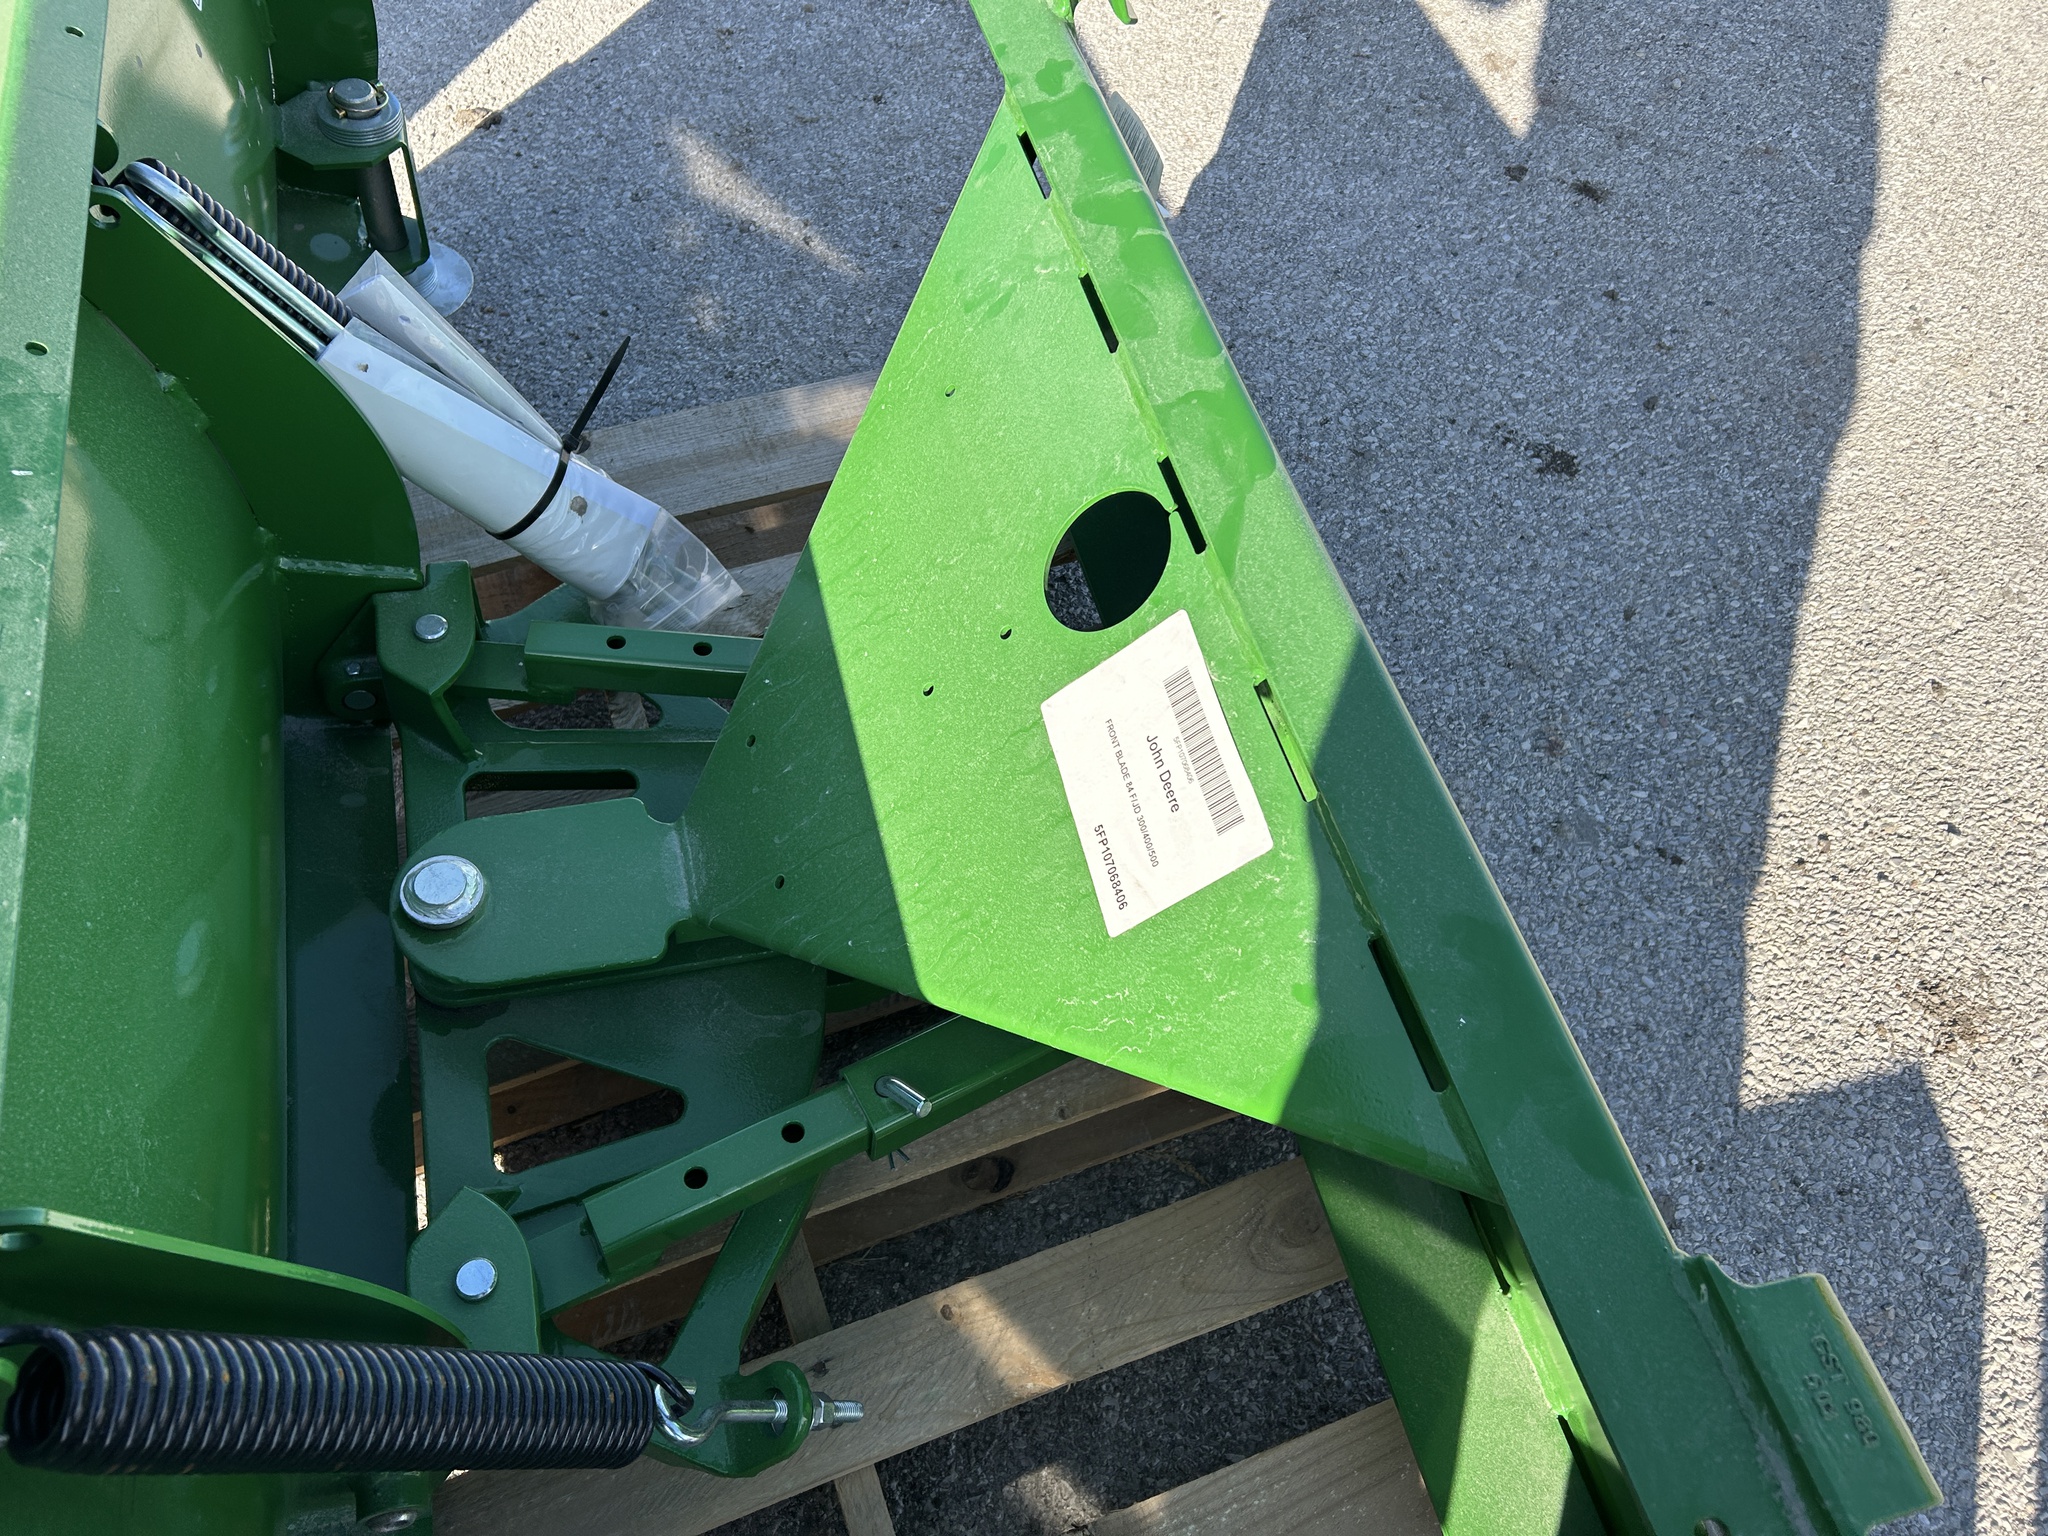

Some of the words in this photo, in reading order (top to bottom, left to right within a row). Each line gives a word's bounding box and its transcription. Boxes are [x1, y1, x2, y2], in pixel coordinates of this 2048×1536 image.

[1105, 718, 1121, 748] FRONT
[1115, 750, 1132, 782] BLADE
[1125, 781, 1137, 794] 84
[1136, 814, 1159, 868] 300/400/500
[1147, 734, 1165, 769] John
[1159, 769, 1180, 813] Deere
[1094, 824, 1128, 911] 5FP107068406
